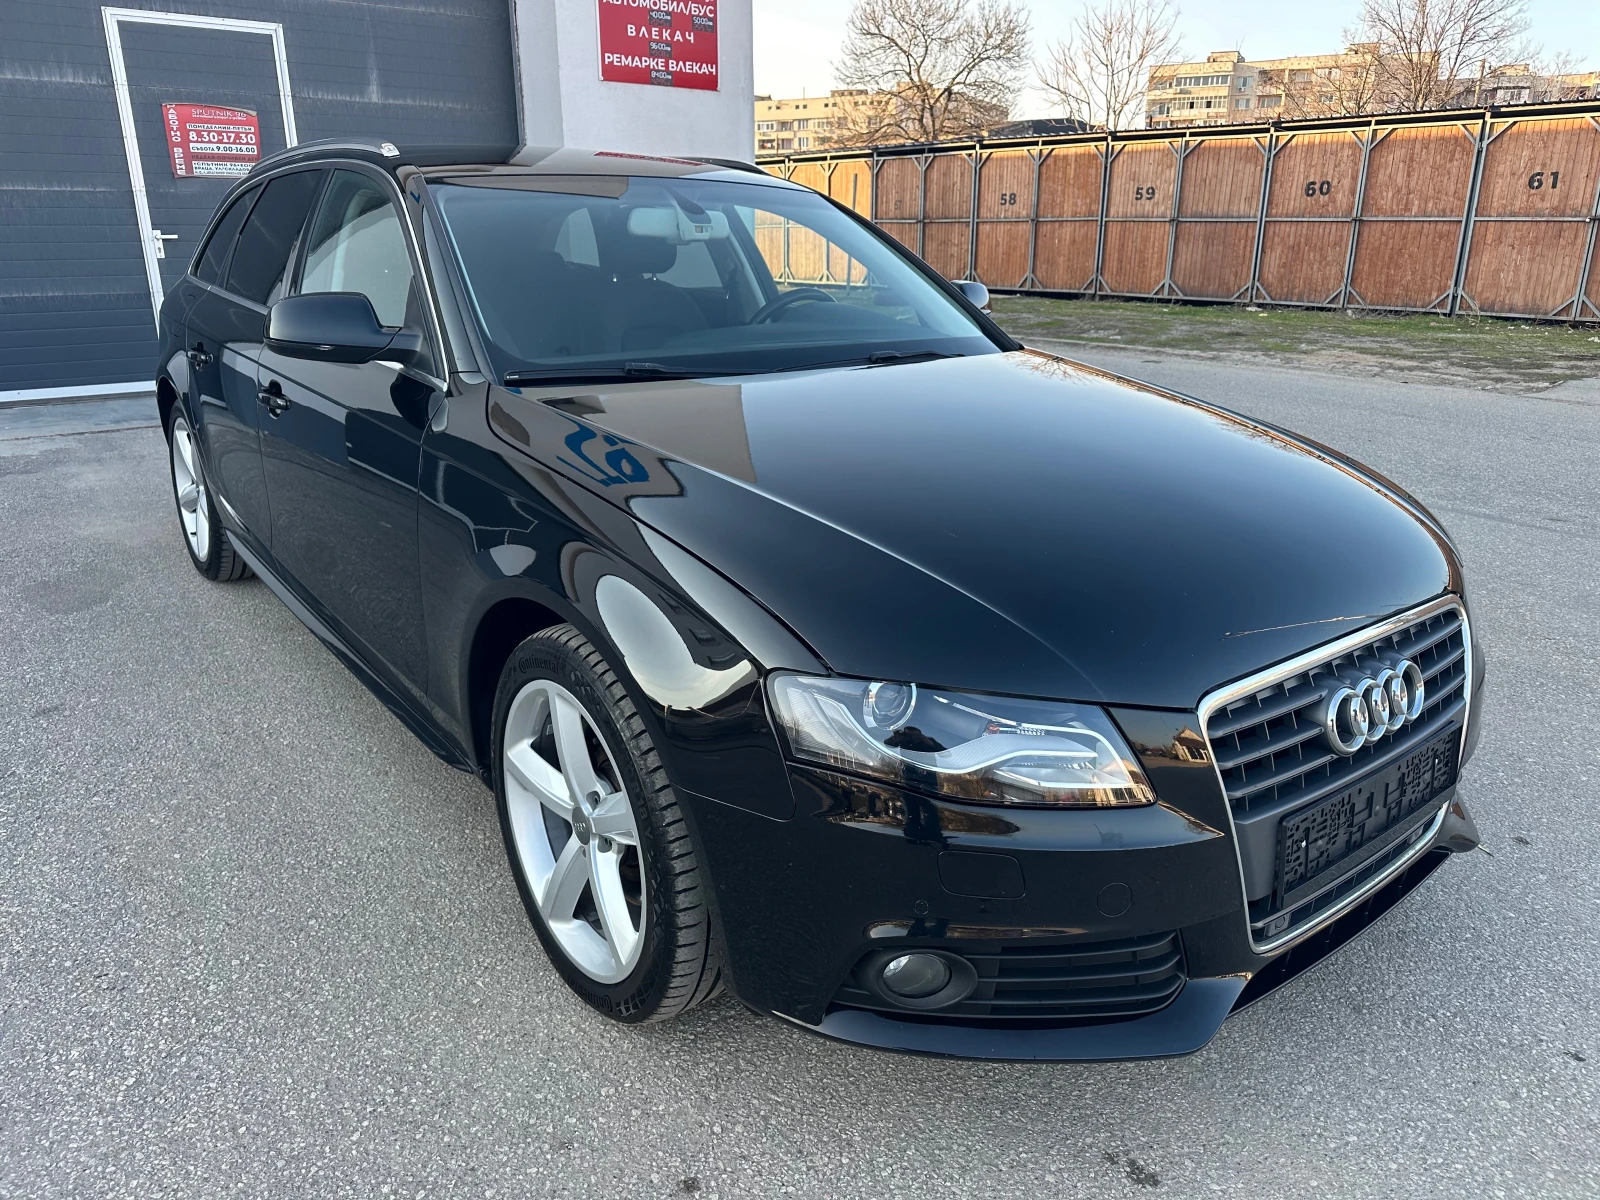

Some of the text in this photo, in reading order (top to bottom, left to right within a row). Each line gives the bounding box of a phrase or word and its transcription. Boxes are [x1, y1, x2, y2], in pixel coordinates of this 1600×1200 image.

[603, 0, 715, 17] ОМОБИЛ/БУС
[627, 24, 694, 43] ВЛЕКАЧ
[604, 53, 716, 75] РЕМАРКЕ ВЛЕКАЧ
[191, 109, 233, 117] SPUTNIK
[189, 131, 256, 143] 8.30-17.30
[215, 145, 256, 153] 9.00-16.00
[1304, 180, 1332, 197] 60
[1528, 171, 1560, 190] 61
[1000, 192, 1017, 206] 58
[1135, 186, 1156, 201] 59
[518, 653, 560, 675] Continental
